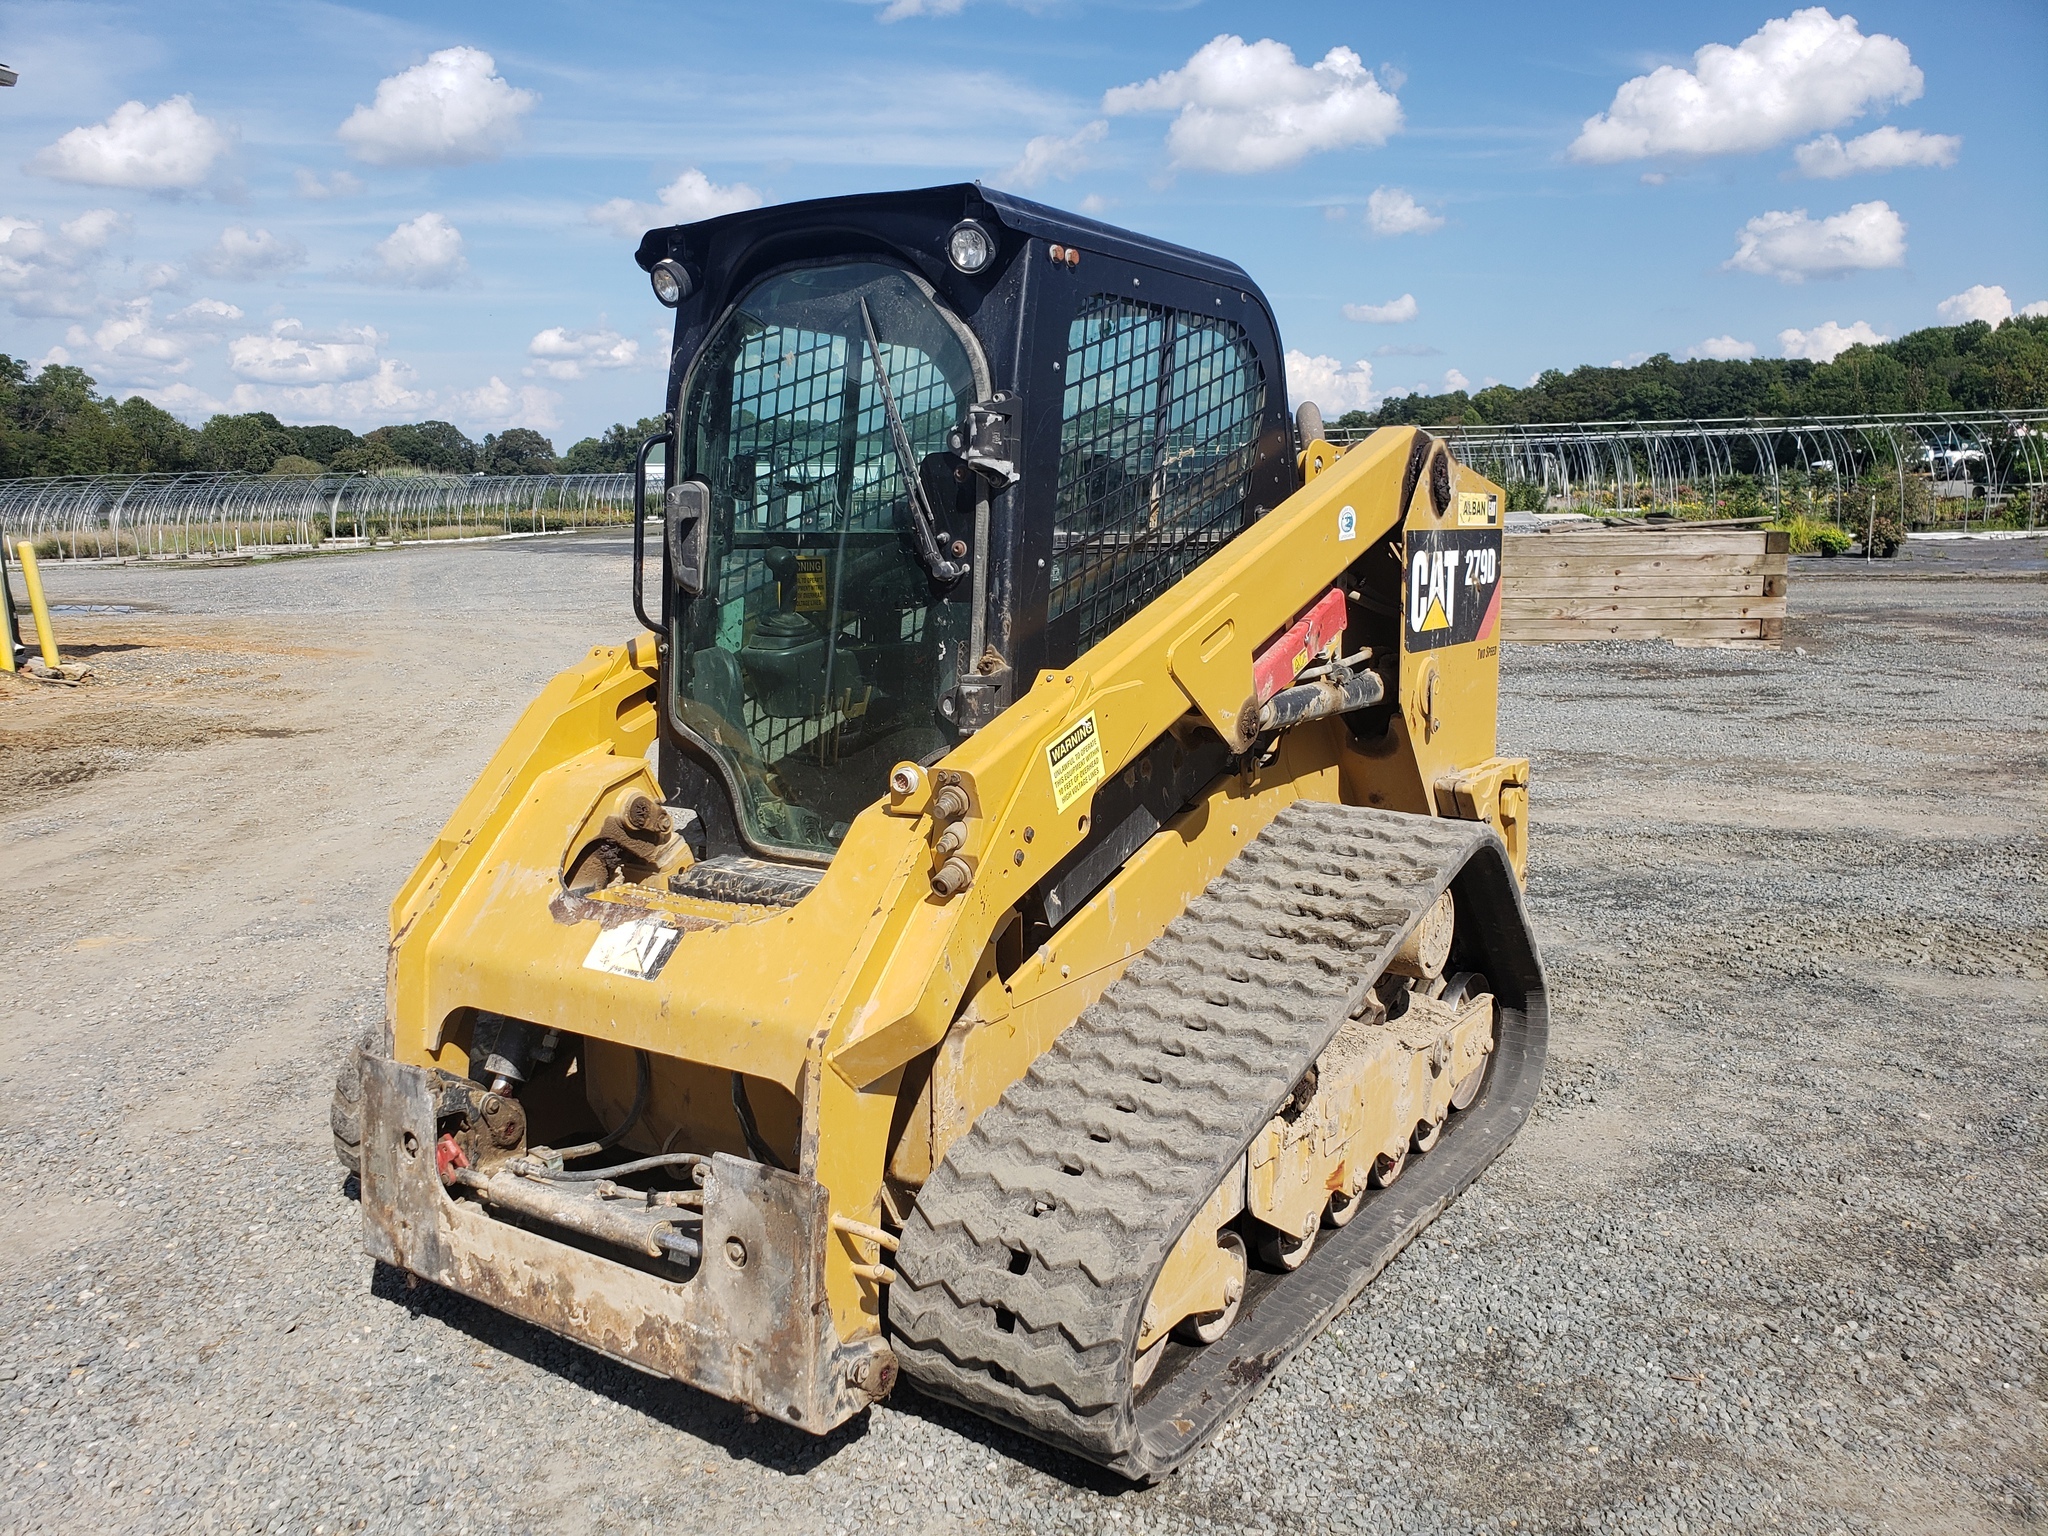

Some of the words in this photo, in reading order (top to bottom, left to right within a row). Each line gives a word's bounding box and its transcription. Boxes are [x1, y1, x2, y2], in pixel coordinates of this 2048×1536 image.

[1463, 500, 1486, 516] ALBAN
[1411, 550, 1459, 632] CAT
[1465, 548, 1496, 586] 279D
[1051, 722, 1093, 762] WARNING
[1054, 757, 1075, 778] UNLAWFUL
[1075, 751, 1080, 760] TO
[1081, 738, 1097, 756] OPERATE
[1054, 776, 1064, 788] THIS
[1064, 758, 1086, 780] EQUIPMENT
[1085, 746, 1099, 762] WITHIN
[1062, 791, 1072, 804] HIGH
[1072, 776, 1088, 795] VOLTAGE
[1088, 767, 1099, 781] LINES
[1063, 779, 1074, 791] FEET
[1074, 773, 1079, 783] OF
[1079, 757, 1099, 778] OVERHEAD
